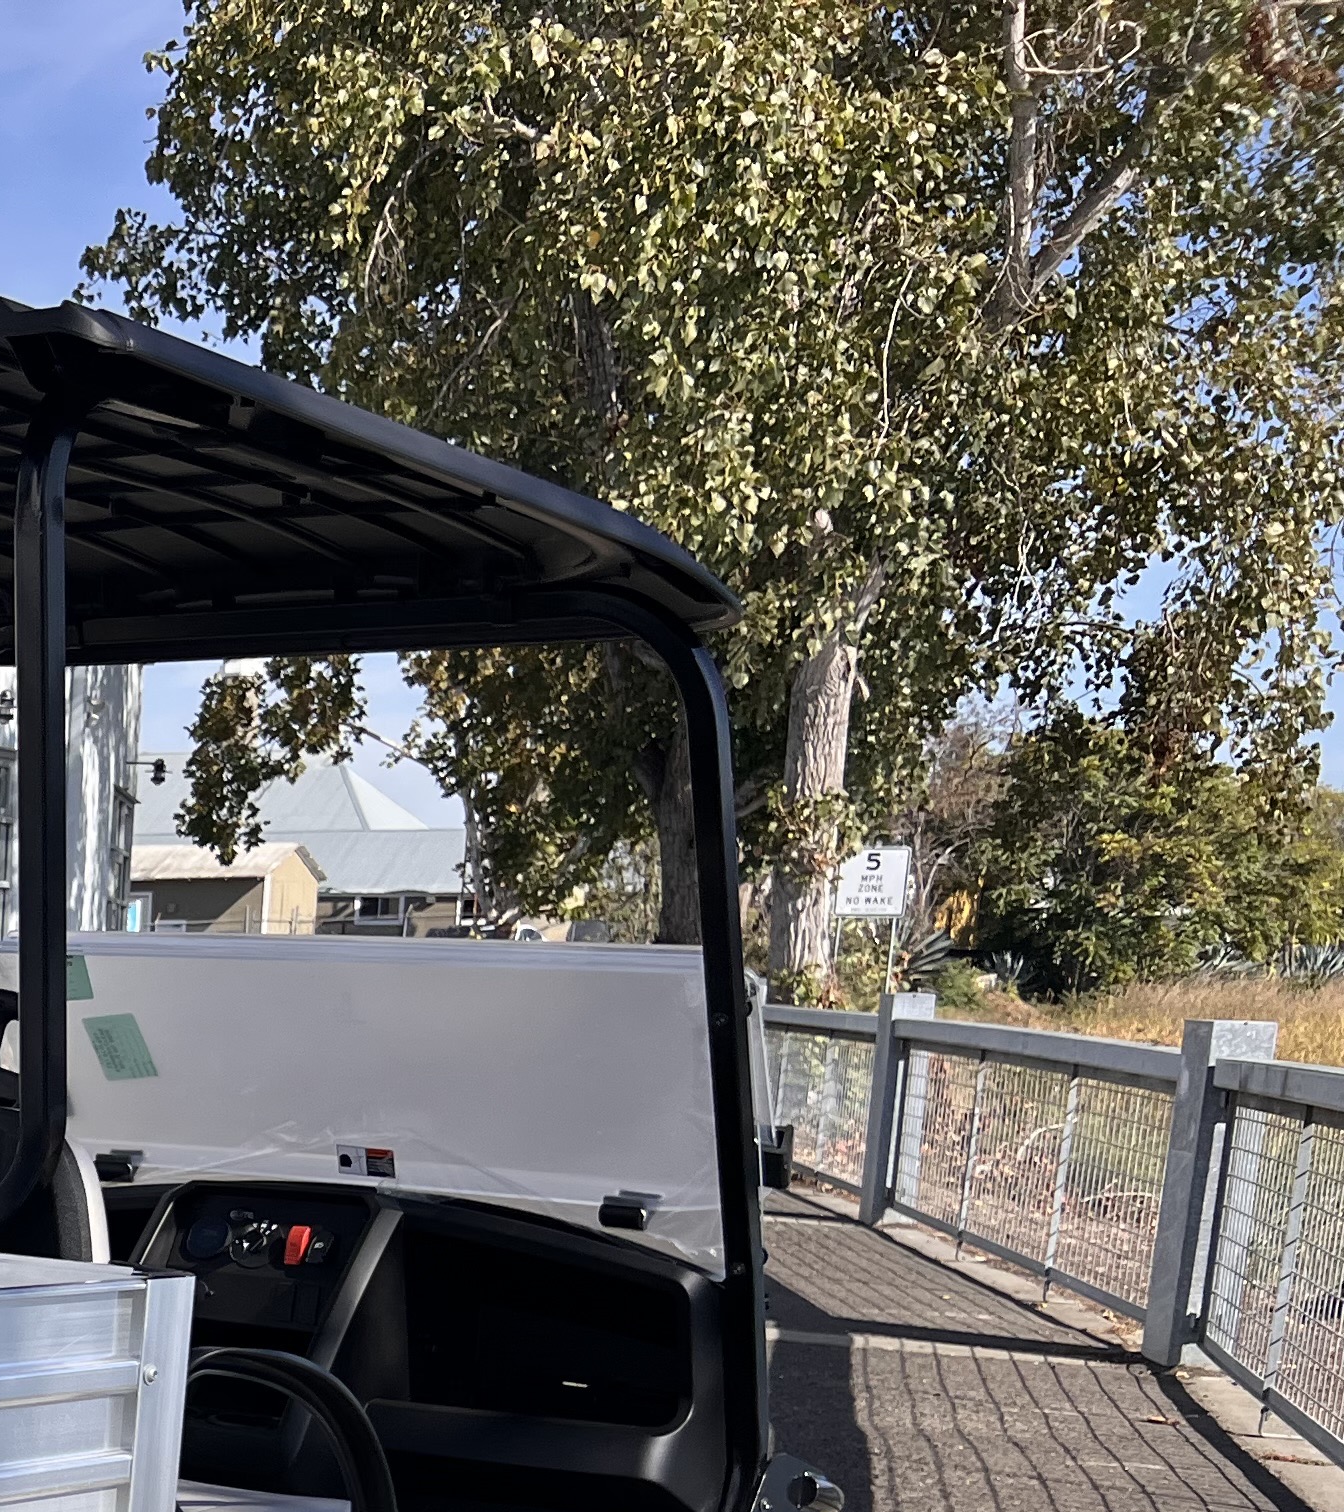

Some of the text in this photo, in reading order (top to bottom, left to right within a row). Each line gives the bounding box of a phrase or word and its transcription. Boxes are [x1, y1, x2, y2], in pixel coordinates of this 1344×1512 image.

[865, 852, 882, 871] 5
[861, 874, 883, 883] MPH
[858, 884, 884, 893] ZONE
[845, 896, 893, 905] NO WAKE
